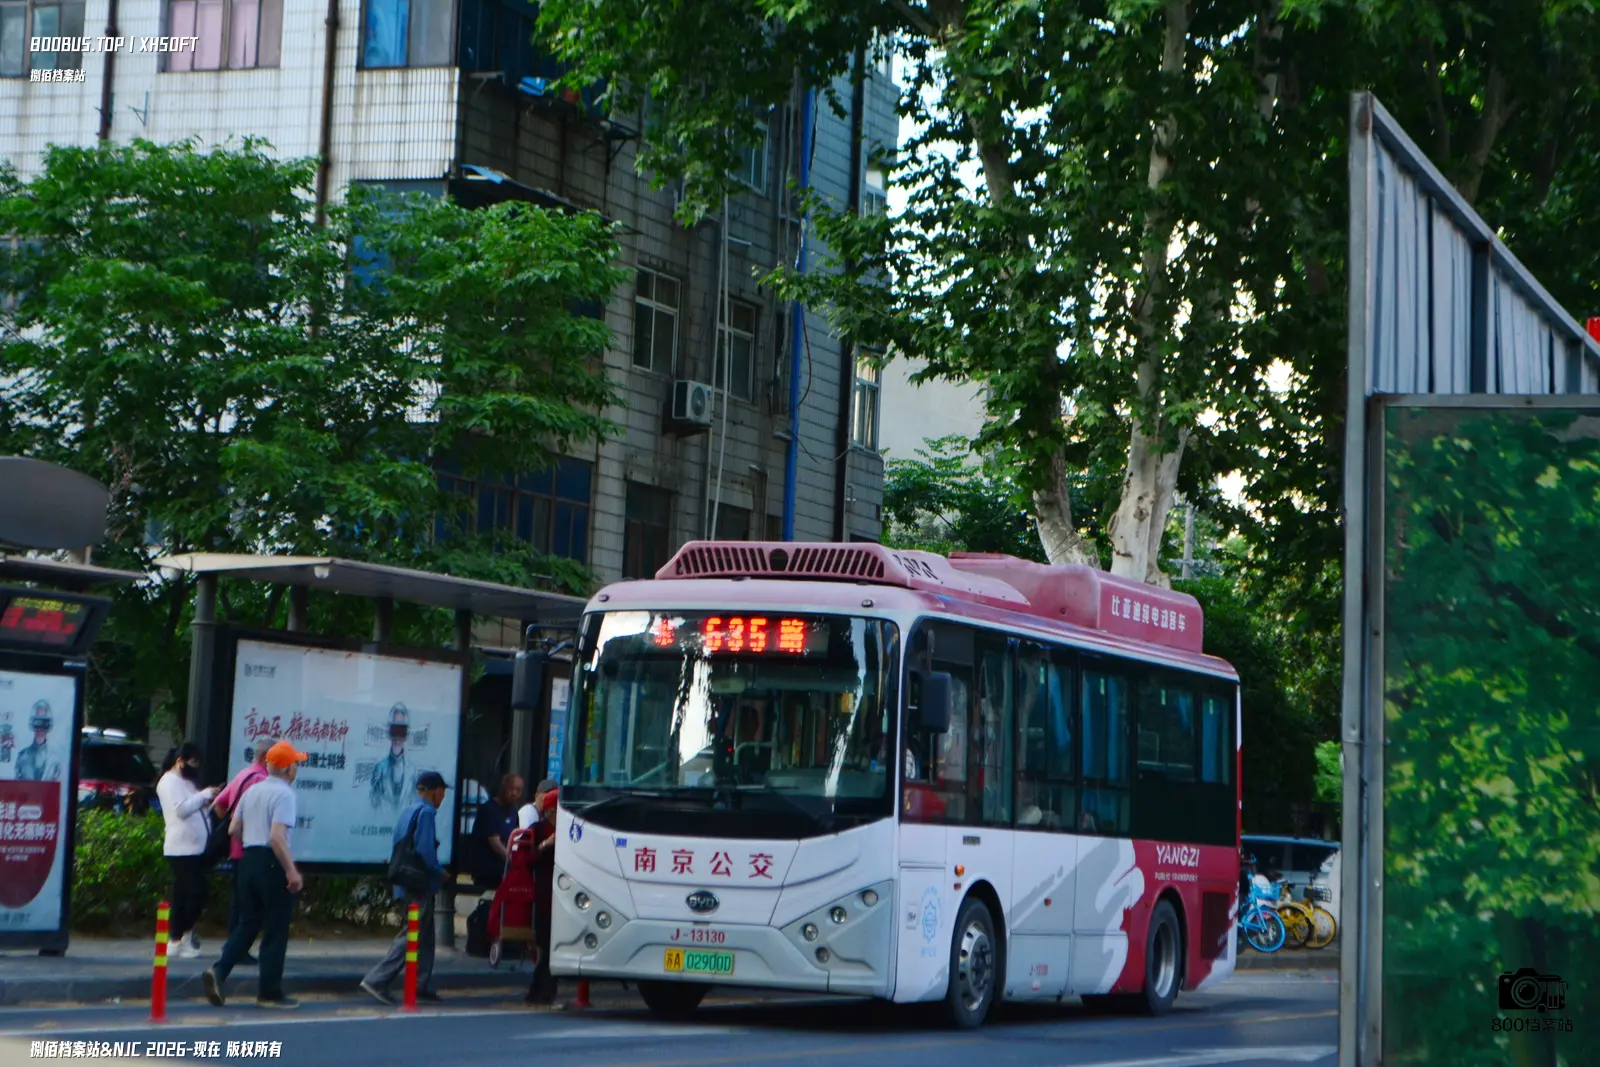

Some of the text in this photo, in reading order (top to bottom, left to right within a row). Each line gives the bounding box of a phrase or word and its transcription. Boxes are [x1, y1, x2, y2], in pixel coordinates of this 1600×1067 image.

[1111, 594, 1187, 632] 比亚迪纯电动客车
[634, 847, 774, 879] 南京公交
[1156, 844, 1200, 868] YANGZI
